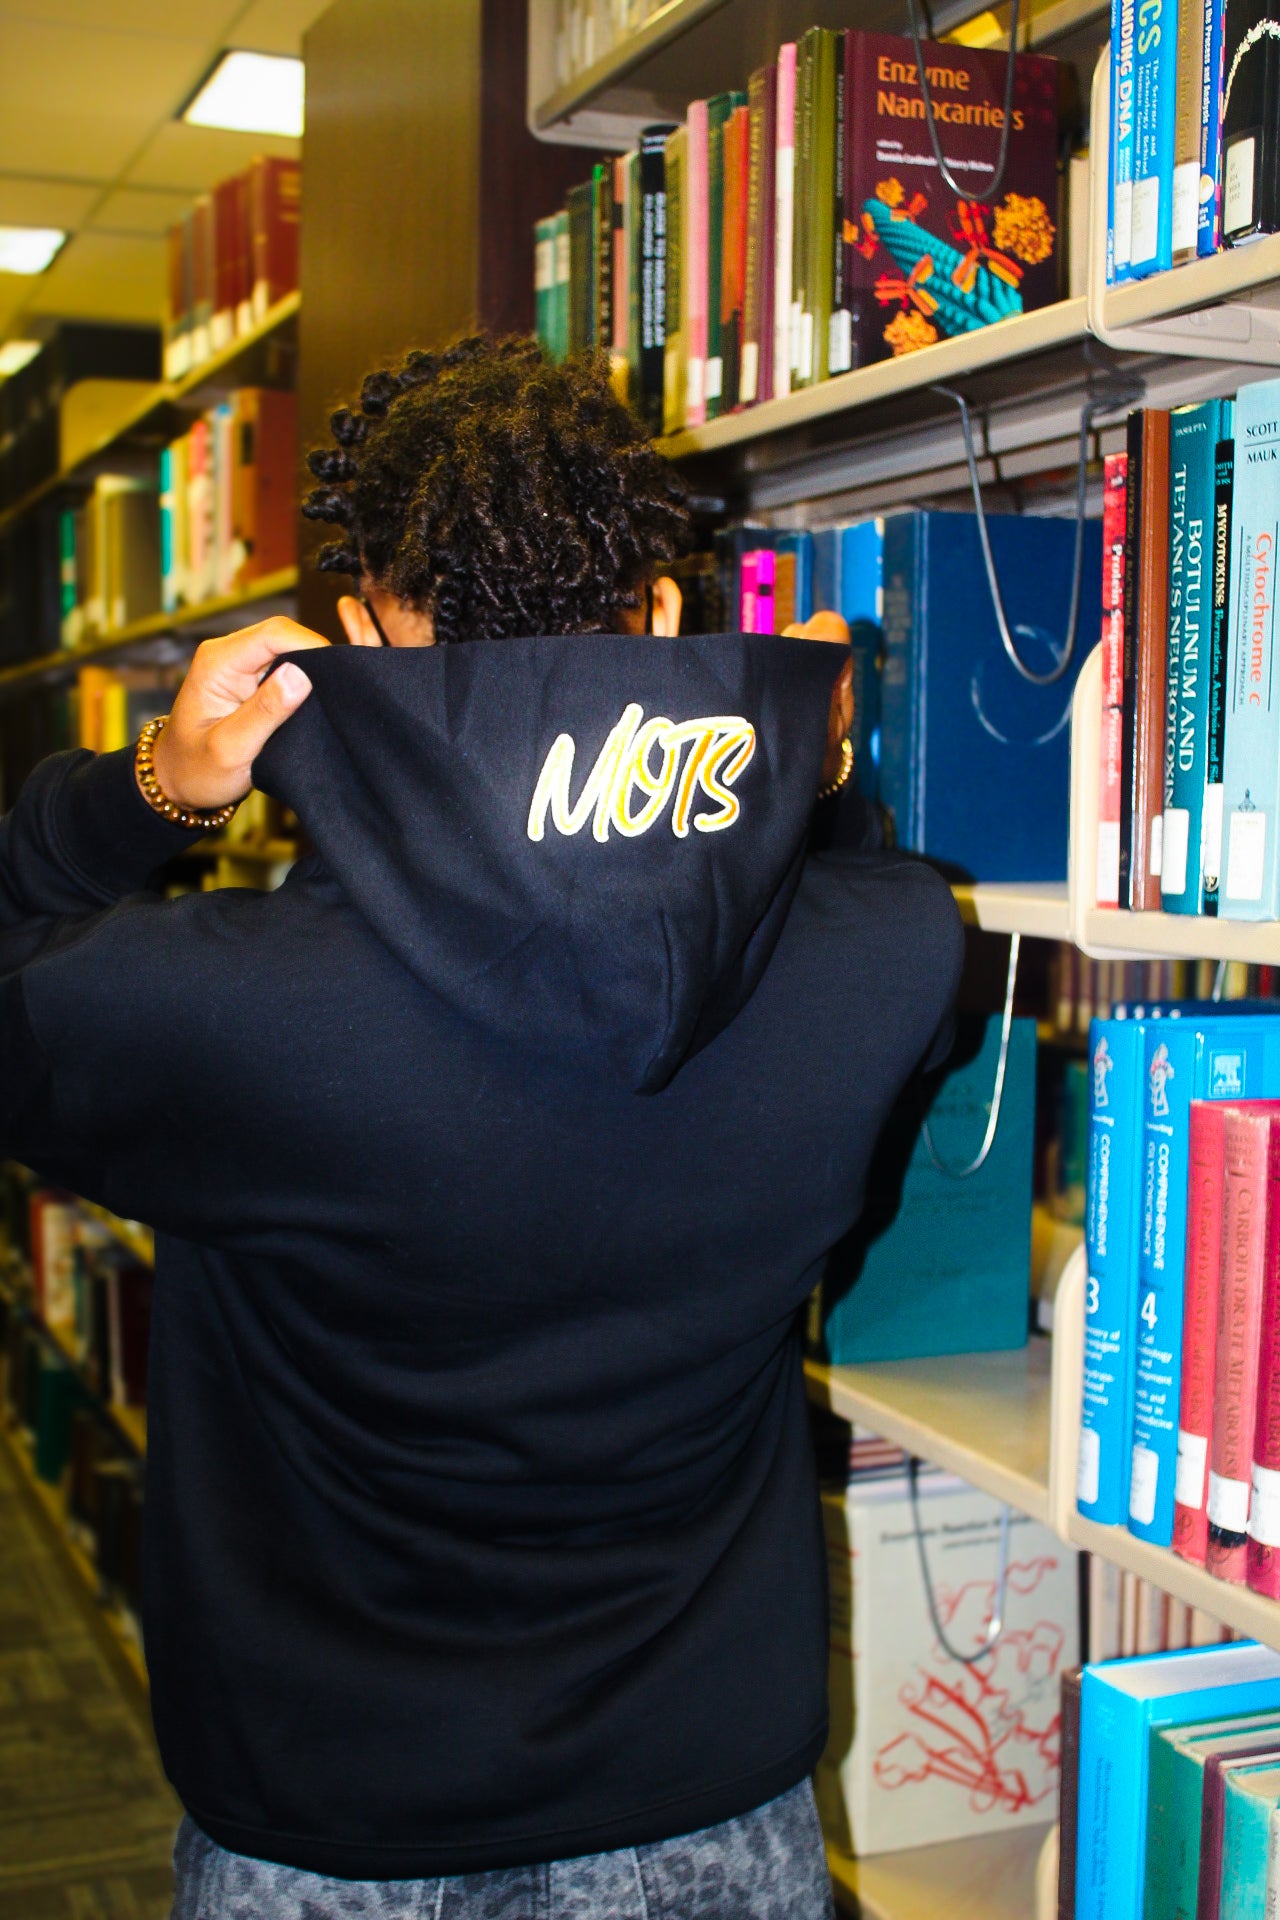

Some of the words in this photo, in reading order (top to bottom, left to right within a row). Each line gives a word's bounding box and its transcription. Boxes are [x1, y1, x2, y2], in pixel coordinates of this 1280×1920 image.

[1139, 0, 1162, 55] CS
[1203, 24, 1212, 66] Process
[1142, 62, 1152, 130] Technology
[1203, 66, 1211, 84] and
[876, 90, 1025, 130] Nanocarries
[1119, 80, 1133, 142] DNA
[1151, 84, 1159, 129] Science
[1202, 85, 1211, 125] Analysis
[1246, 421, 1278, 438] SCOTT
[1246, 448, 1278, 464] MAUK
[1170, 463, 1187, 608] TETANUS
[1111, 543, 1123, 605] Protein
[1181, 518, 1203, 699] BOTULINUM
[1249, 532, 1273, 683] Cytochrome
[1107, 608, 1122, 704] Sequencing
[1238, 651, 1247, 706] APPROACH
[1163, 614, 1182, 808] NEUROTOXIN
[1210, 680, 1222, 735] Analysis
[1248, 692, 1261, 706] c
[1106, 708, 1119, 786] Protocols
[1178, 705, 1195, 772] AND
[1210, 737, 1219, 762] and
[527, 703, 756, 843] MOTS
[1096, 1133, 1112, 1257] COMPREHENSIVE
[1152, 1142, 1171, 1271] COMPREHENSIVE
[1086, 1276, 1100, 1315] 3
[1232, 1188, 1252, 1348] CARBOHYDRATE
[1141, 1291, 1158, 1330] 4
